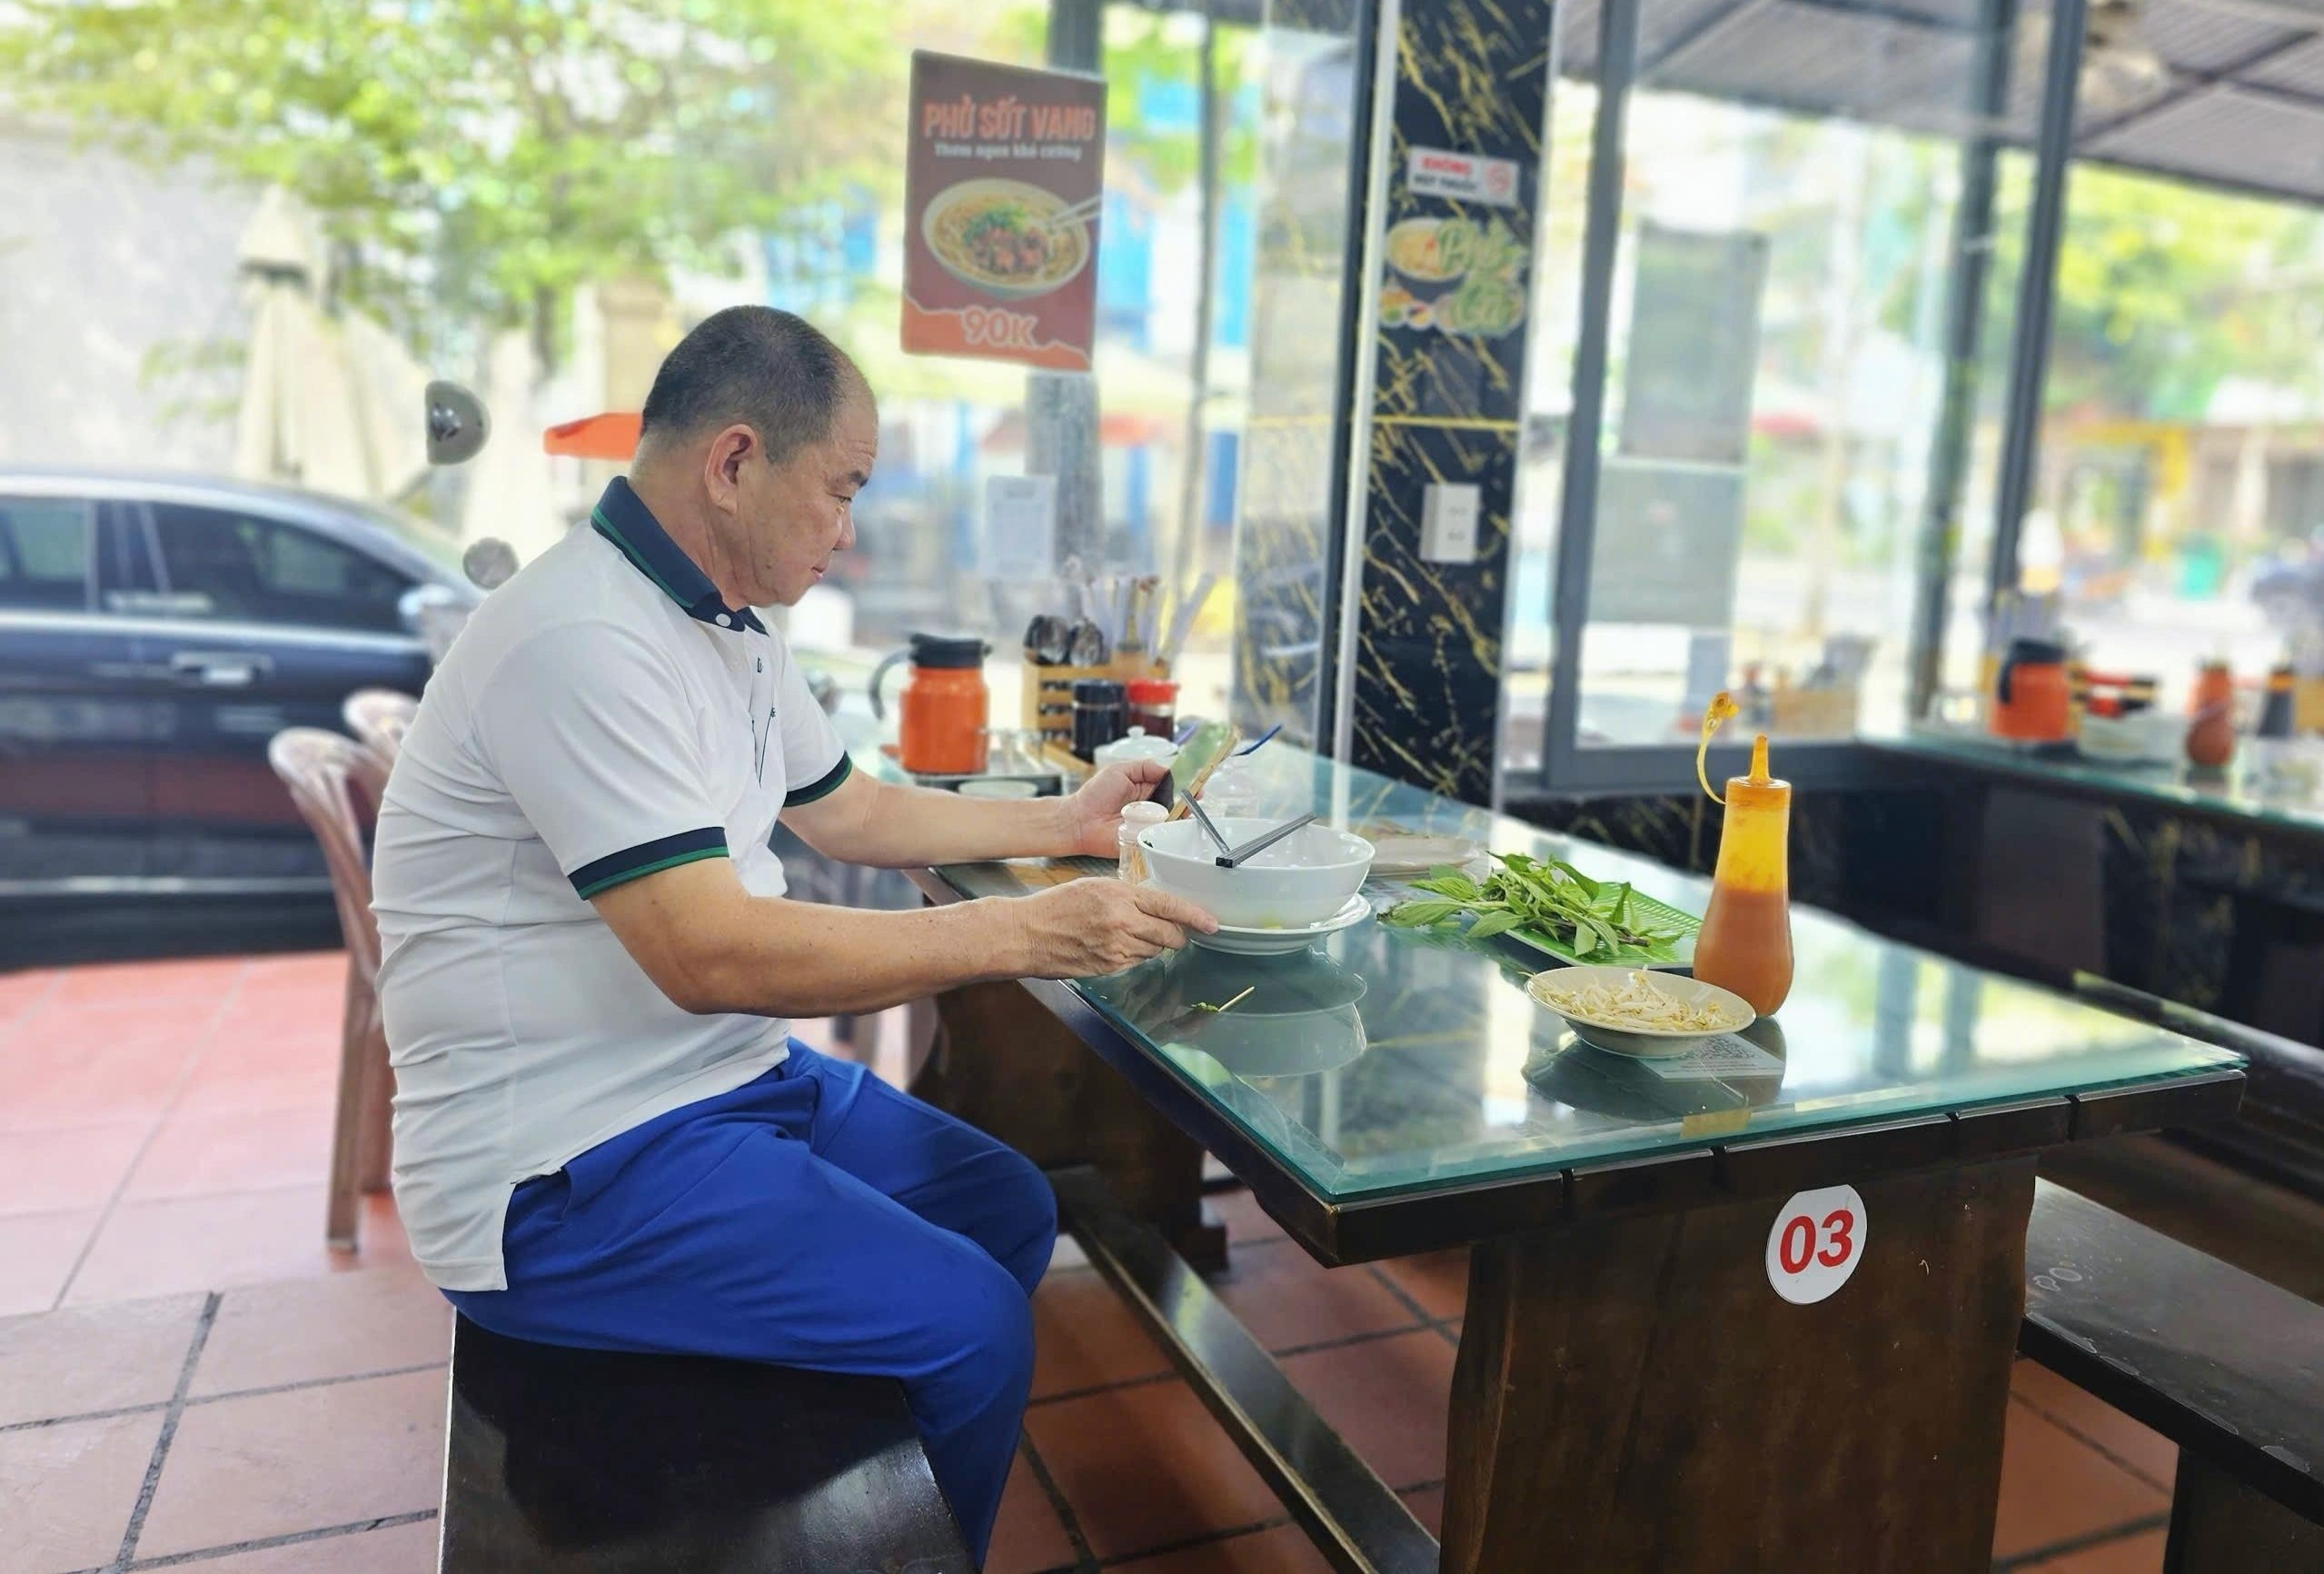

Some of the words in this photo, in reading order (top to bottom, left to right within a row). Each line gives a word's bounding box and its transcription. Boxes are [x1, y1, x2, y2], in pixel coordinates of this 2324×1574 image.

[923, 93, 976, 139] PHỞ
[978, 94, 1028, 139] SỐT
[1029, 105, 1096, 141] VANG
[961, 305, 1038, 348] 90K
[1779, 1209, 1854, 1275] 03
